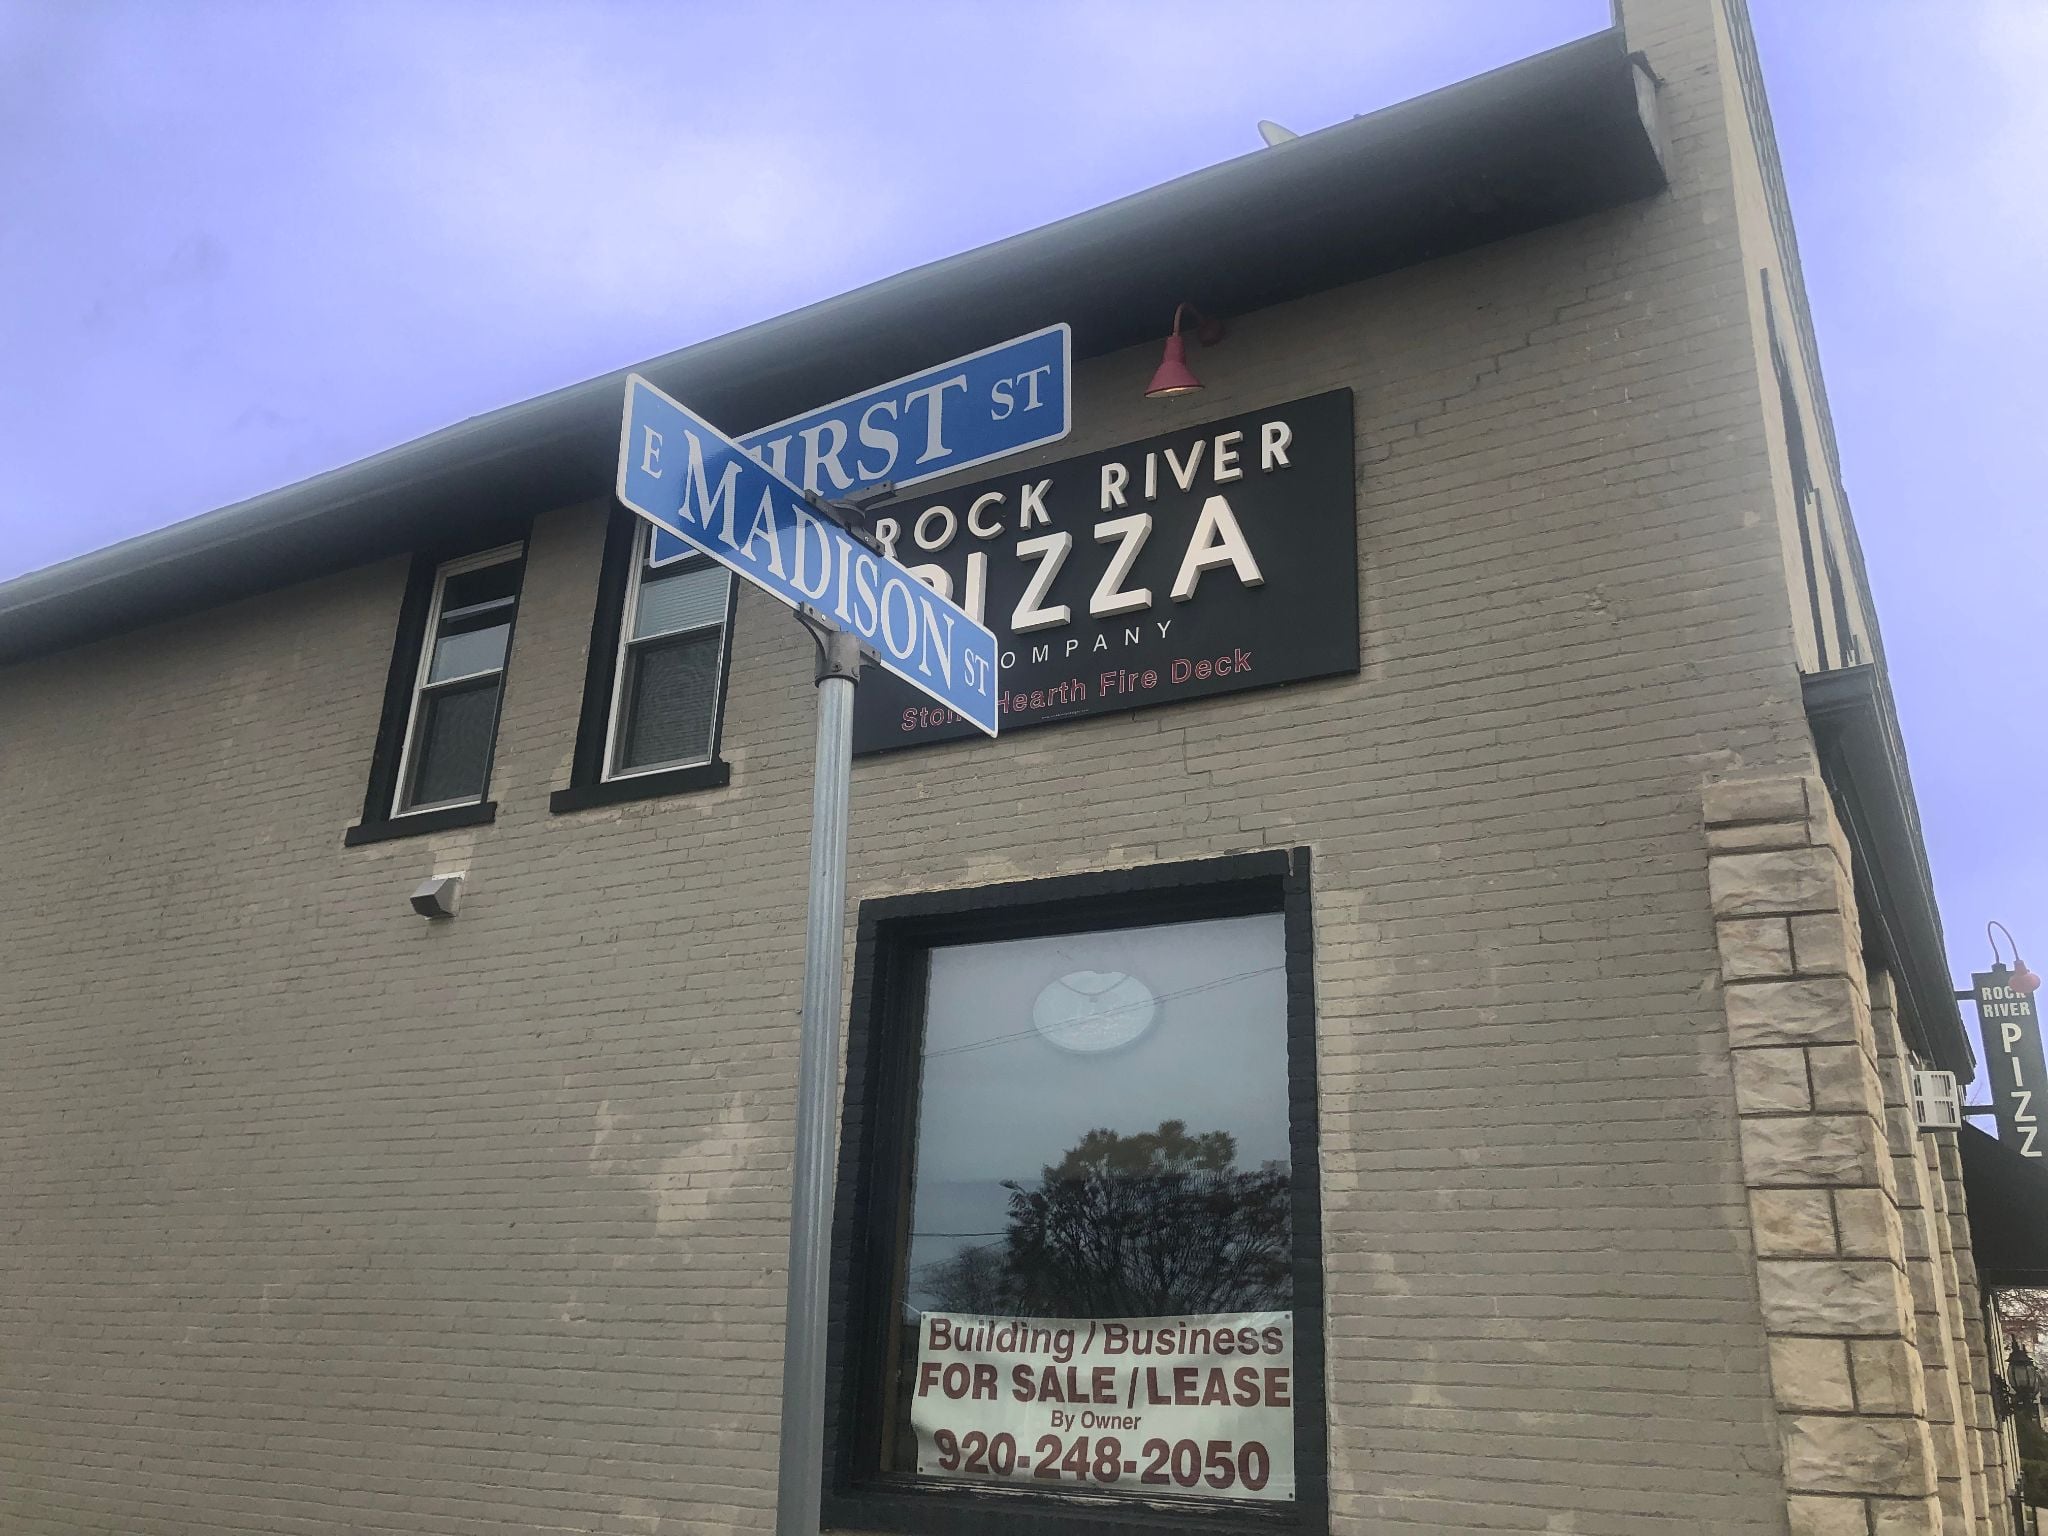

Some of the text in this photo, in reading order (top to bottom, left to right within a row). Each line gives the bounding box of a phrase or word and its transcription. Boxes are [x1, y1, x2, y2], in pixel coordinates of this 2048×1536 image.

[746, 364, 1051, 497] IRST ST
[876, 420, 1293, 559] ROCK RIVER
[641, 425, 989, 697] E MADISON ST
[1000, 619, 1172, 669] OMPANY
[901, 648, 1252, 731] Sto Hearth Fire Deck
[1983, 1002, 2031, 1018] RIVER
[2000, 1022, 2043, 1157] PIZZ
[918, 1362, 998, 1400] FOR
[1051, 1410, 1142, 1432] By Owner
[933, 1428, 1271, 1492] 920-248-2050
